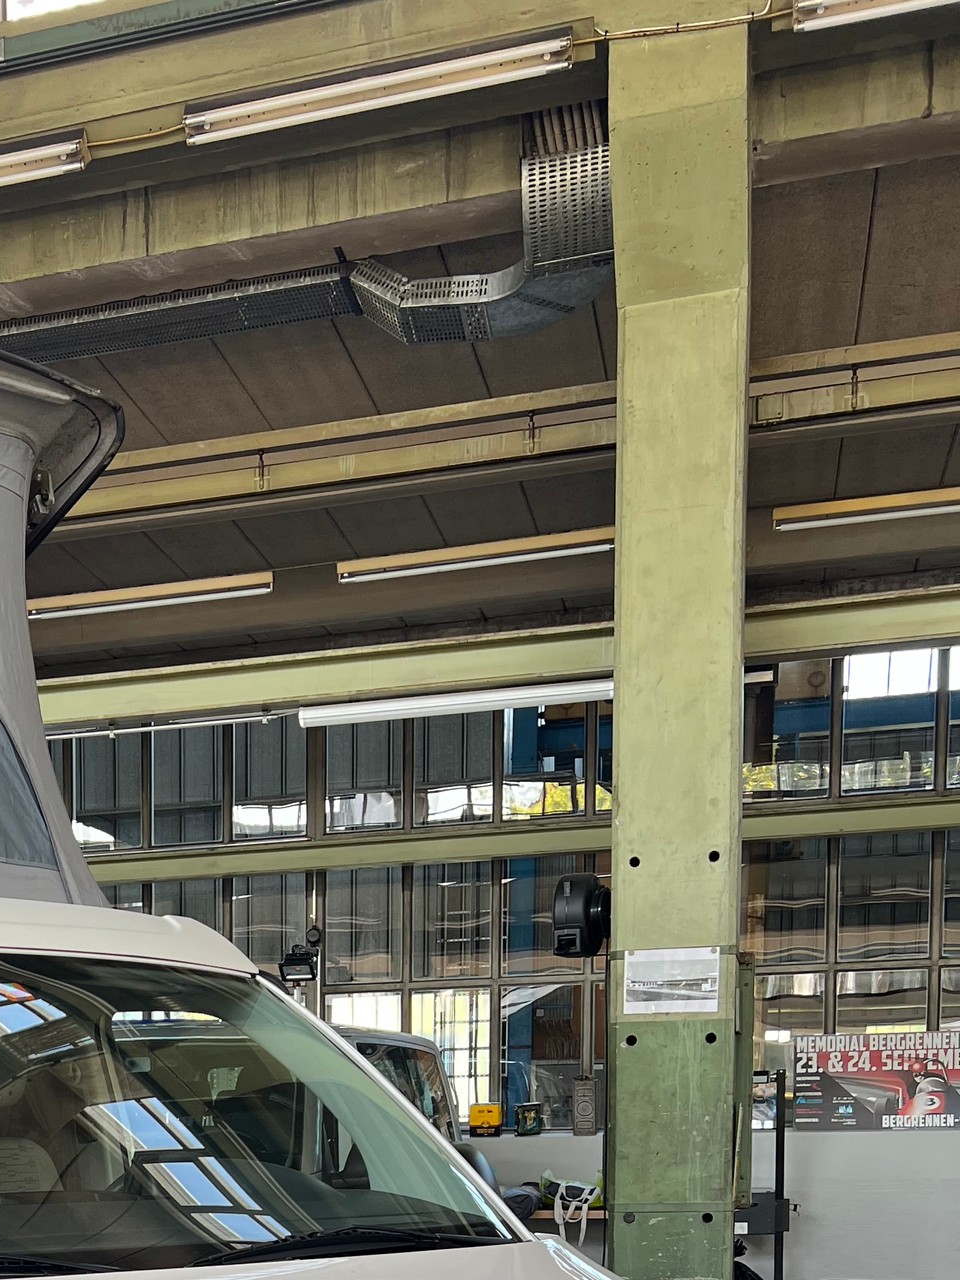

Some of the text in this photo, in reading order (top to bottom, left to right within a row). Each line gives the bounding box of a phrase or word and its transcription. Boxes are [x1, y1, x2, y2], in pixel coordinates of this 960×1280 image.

[796, 1032, 960, 1052] MEMORIAL BERGRENNEN
[796, 1053, 824, 1073] 23.
[827, 1052, 843, 1073] &
[848, 1051, 877, 1072] 24.
[882, 1114, 960, 1128] BERGRENNEN-
